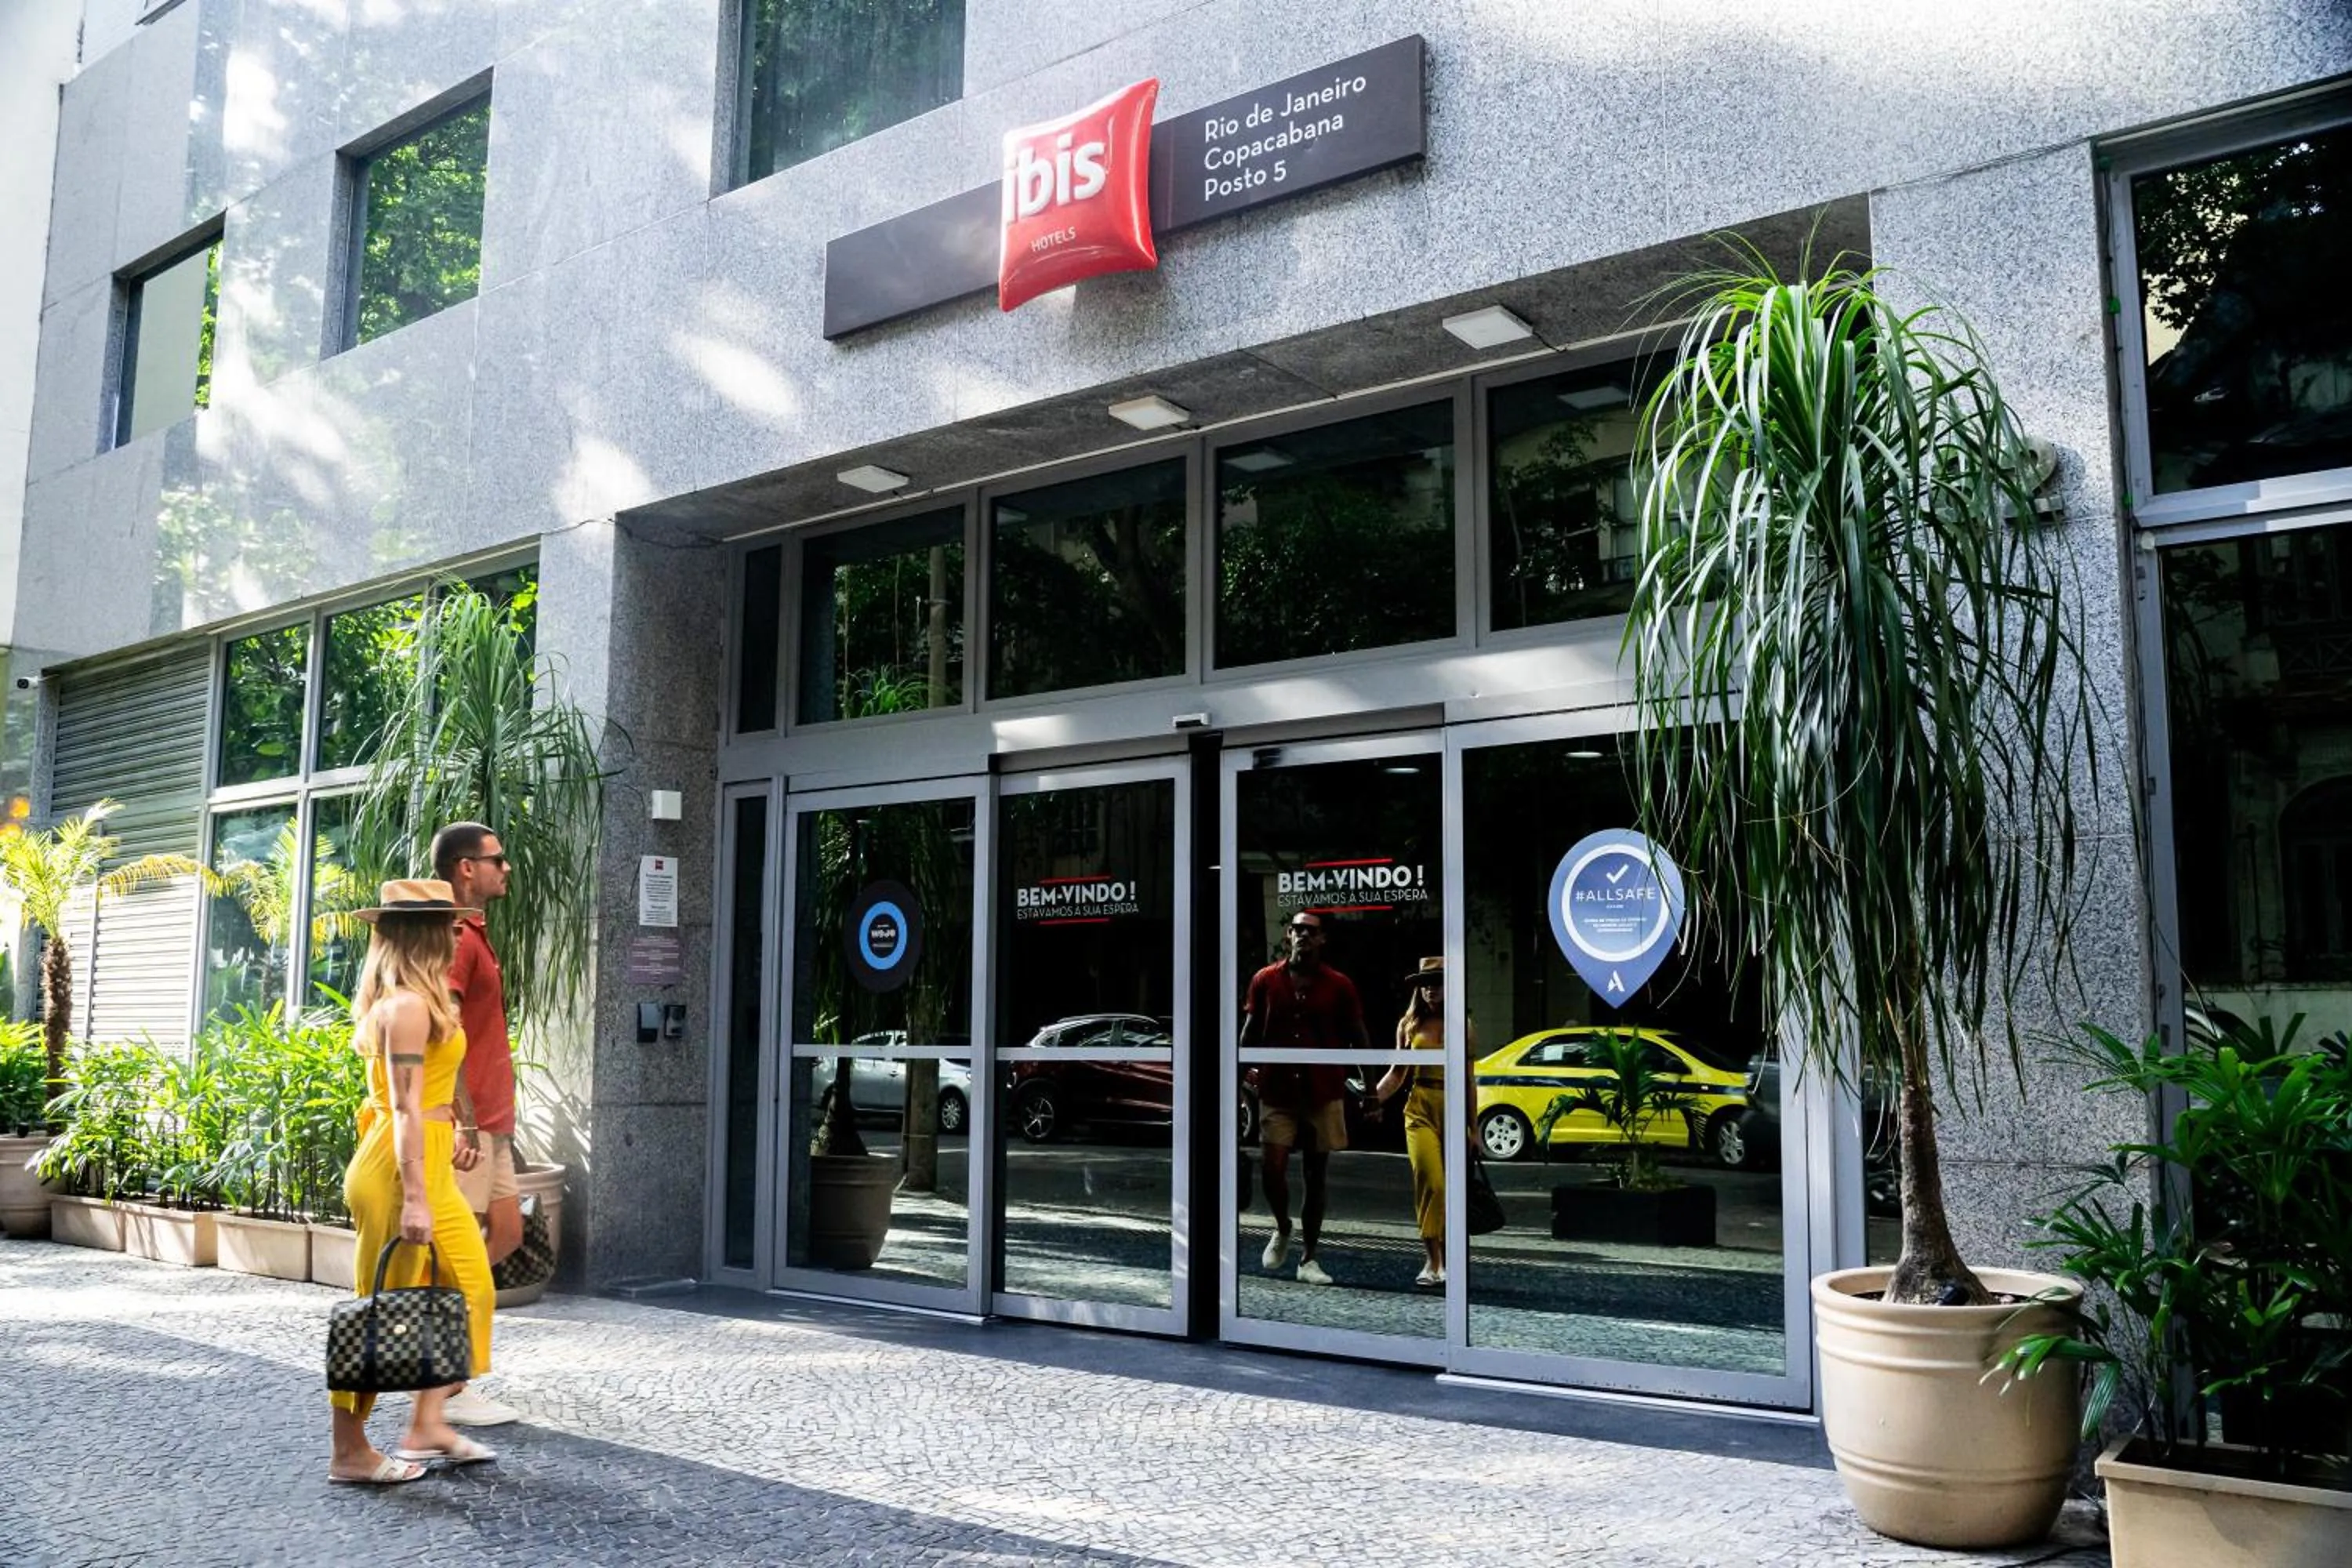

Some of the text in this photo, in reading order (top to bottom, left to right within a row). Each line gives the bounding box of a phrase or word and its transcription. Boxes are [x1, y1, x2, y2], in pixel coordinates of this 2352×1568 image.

[1205, 76, 1367, 143] Rio de Janeiro
[1203, 113, 1343, 170] Copacabana
[1002, 132, 1106, 226] ibis
[1204, 159, 1287, 201] Posto 5
[1031, 227, 1076, 252] HOTELS
[1359, 891, 1381, 902] SUA
[1384, 888, 1428, 902] ESPERA
[1576, 887, 1657, 902] #ALLSAFE
